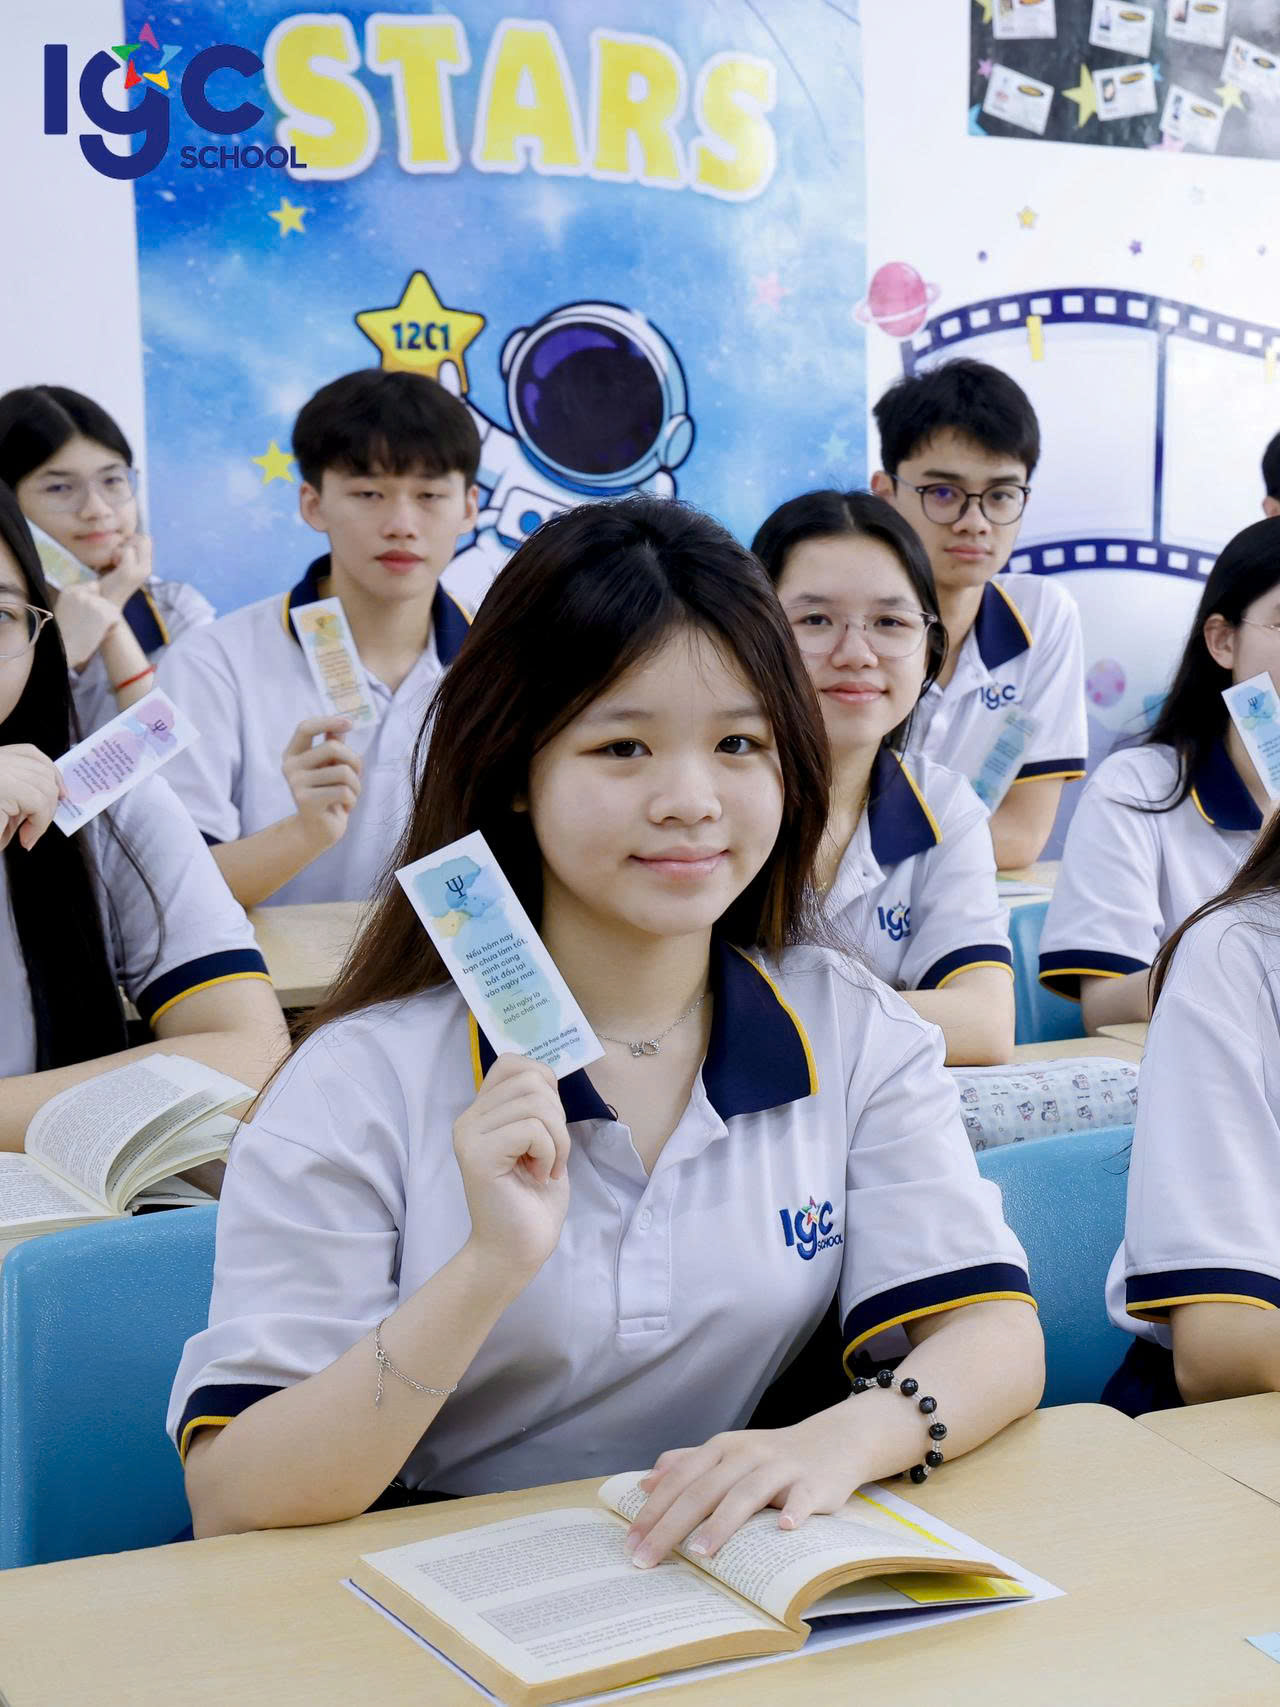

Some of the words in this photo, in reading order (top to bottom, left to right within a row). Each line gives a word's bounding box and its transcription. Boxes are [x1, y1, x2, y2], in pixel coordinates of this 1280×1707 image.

[265, 14, 777, 202] STARS
[391, 322, 450, 351] 12C1
[465, 948, 481, 960] Nếu
[481, 940, 499, 952] hôm
[499, 932, 513, 943] nay
[462, 963, 478, 974] bạn
[479, 953, 498, 965] chưa
[481, 963, 500, 976] mình
[500, 968, 515, 978] đầu
[514, 961, 526, 971] lại
[484, 987, 499, 998] vào
[500, 977, 519, 990] ngày
[817, 1234, 844, 1252] SCHOOL
